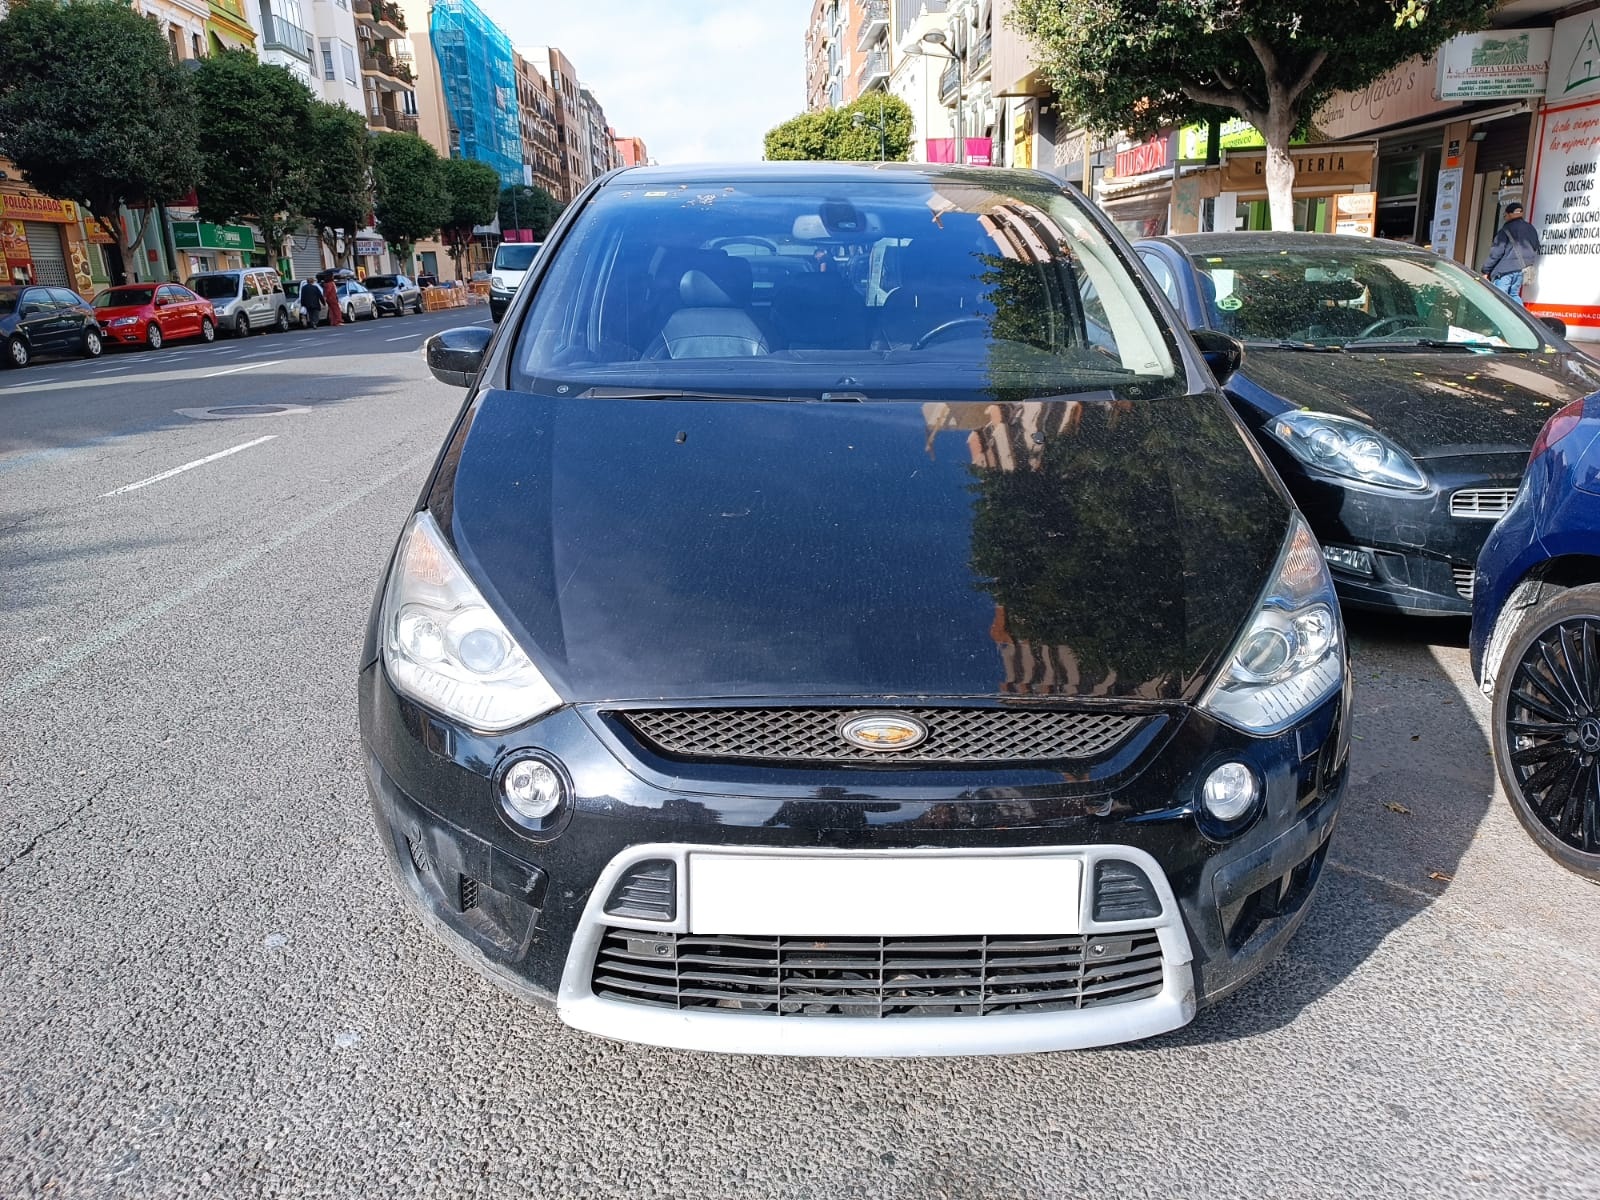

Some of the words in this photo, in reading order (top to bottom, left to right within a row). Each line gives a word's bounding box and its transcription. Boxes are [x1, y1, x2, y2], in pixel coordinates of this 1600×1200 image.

[1255, 154, 1345, 175] CTERÍA
[1566, 161, 1597, 177] SÁBANAS
[1564, 179, 1595, 192] COLCHAS
[2, 195, 32, 209] POLLOS
[33, 198, 63, 211] ASADOS
[1562, 195, 1591, 208] MANTAS
[1544, 212, 1571, 225] FUNDAS
[1542, 228, 1568, 240] FUNDAS
[1537, 244, 1568, 255] RELLENOS
